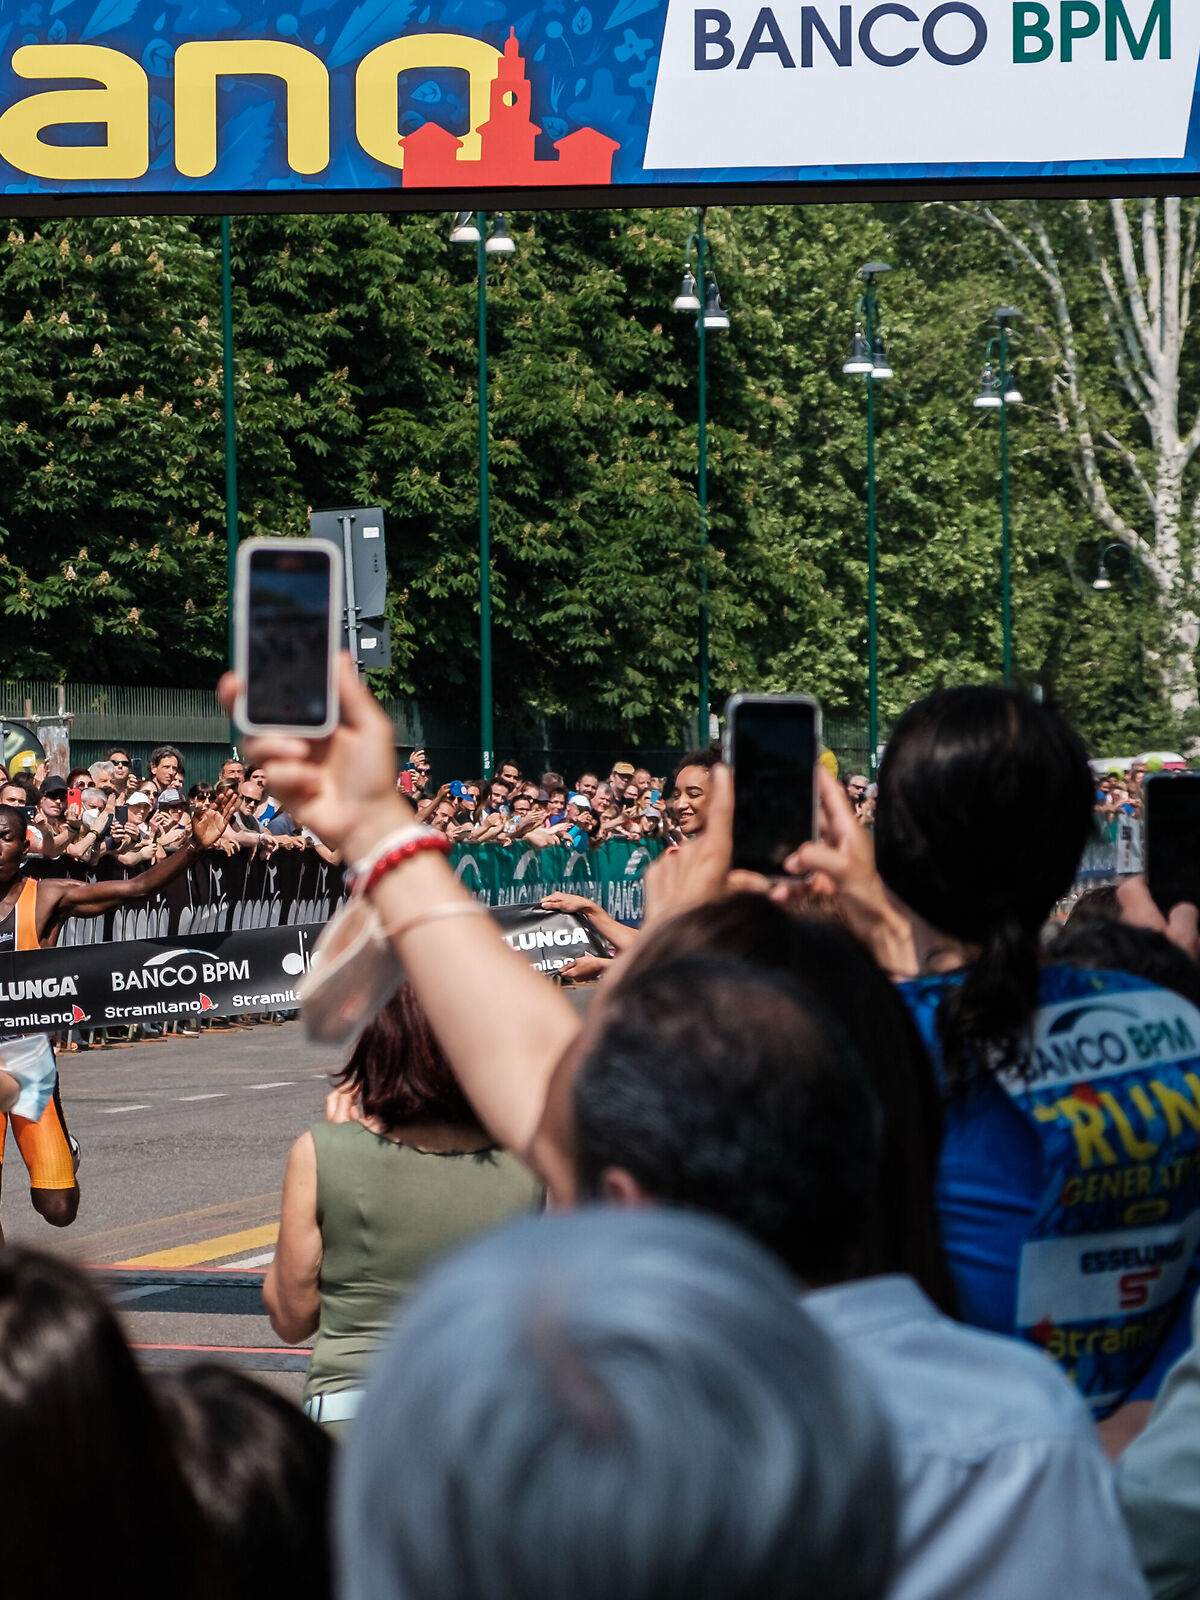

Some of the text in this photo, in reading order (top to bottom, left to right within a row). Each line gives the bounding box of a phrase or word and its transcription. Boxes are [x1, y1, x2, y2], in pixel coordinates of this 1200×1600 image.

[693, 0, 1172, 71] BANCO BPM
[501, 927, 590, 952] LUNGA
[111, 960, 250, 992] BANCO BPM
[105, 989, 303, 1019] Stramilano Stramila
